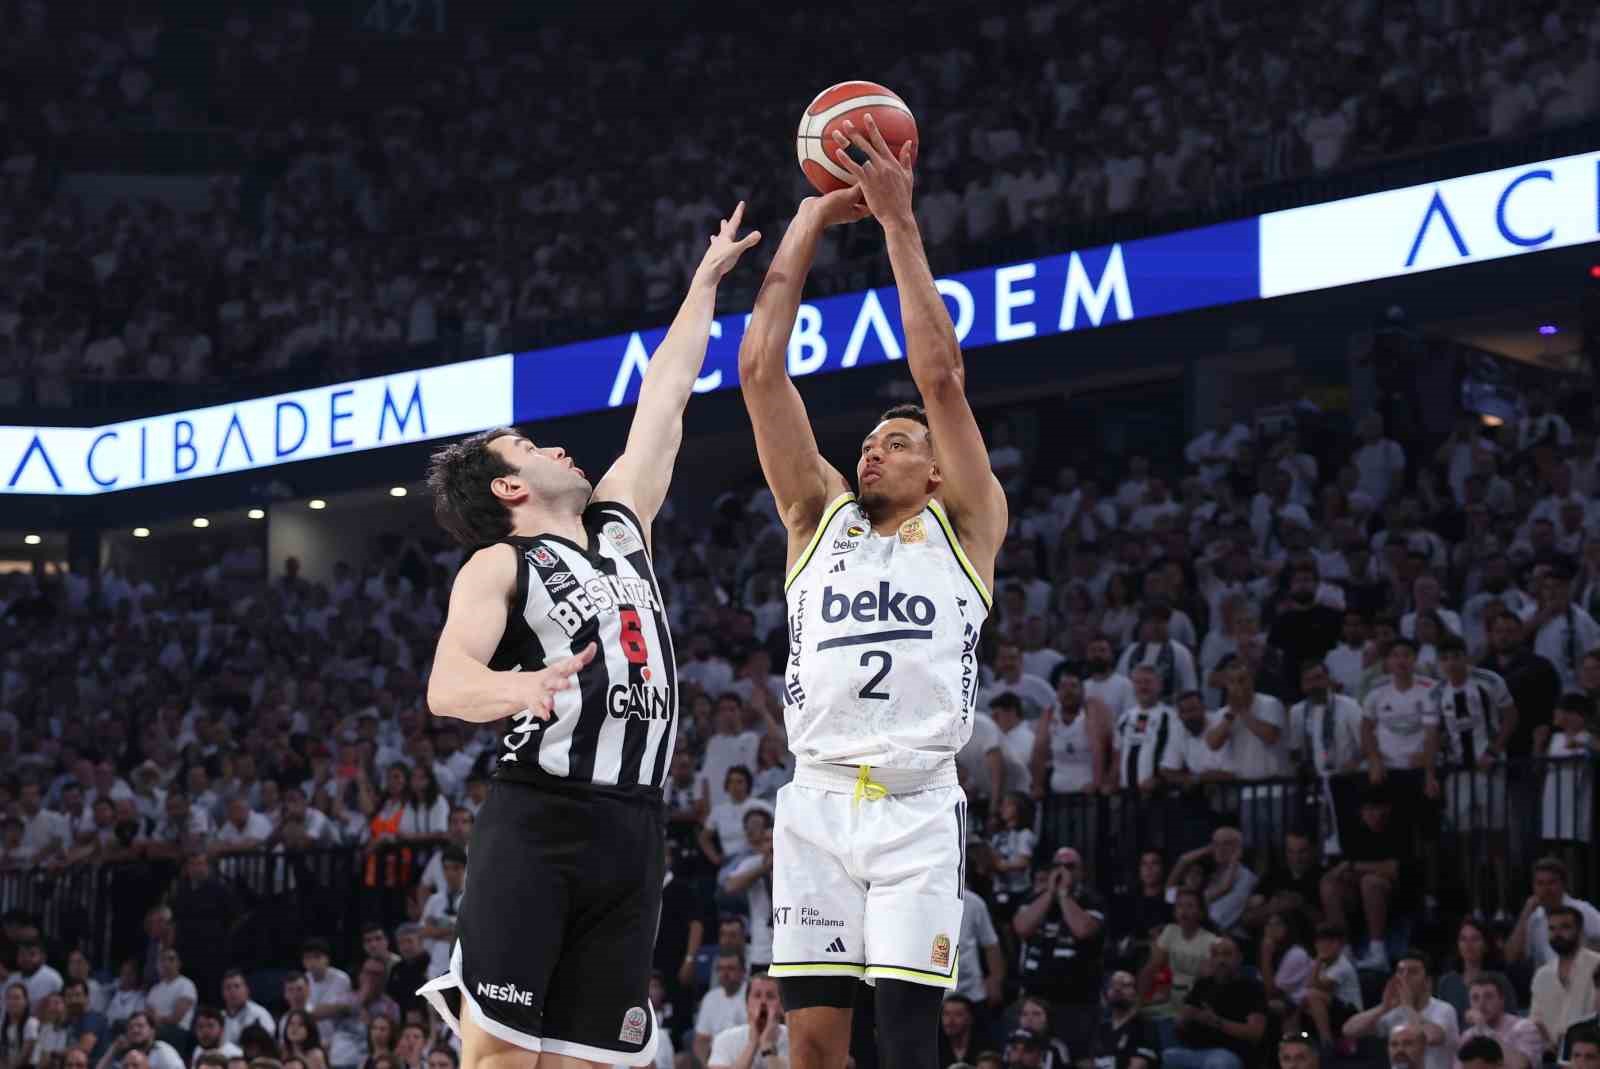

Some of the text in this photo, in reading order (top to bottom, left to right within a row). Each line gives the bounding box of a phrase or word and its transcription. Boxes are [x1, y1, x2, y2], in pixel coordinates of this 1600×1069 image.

[363, 0, 445, 33] 421
[608, 243, 1134, 407] ABADEM
[8, 379, 427, 488] ACIBADEM
[551, 580, 576, 593] umbro
[821, 581, 936, 626] beko
[619, 608, 649, 664] 6
[858, 650, 893, 700] 2
[801, 907, 820, 916] Filo
[801, 917, 845, 927] Kiralama
